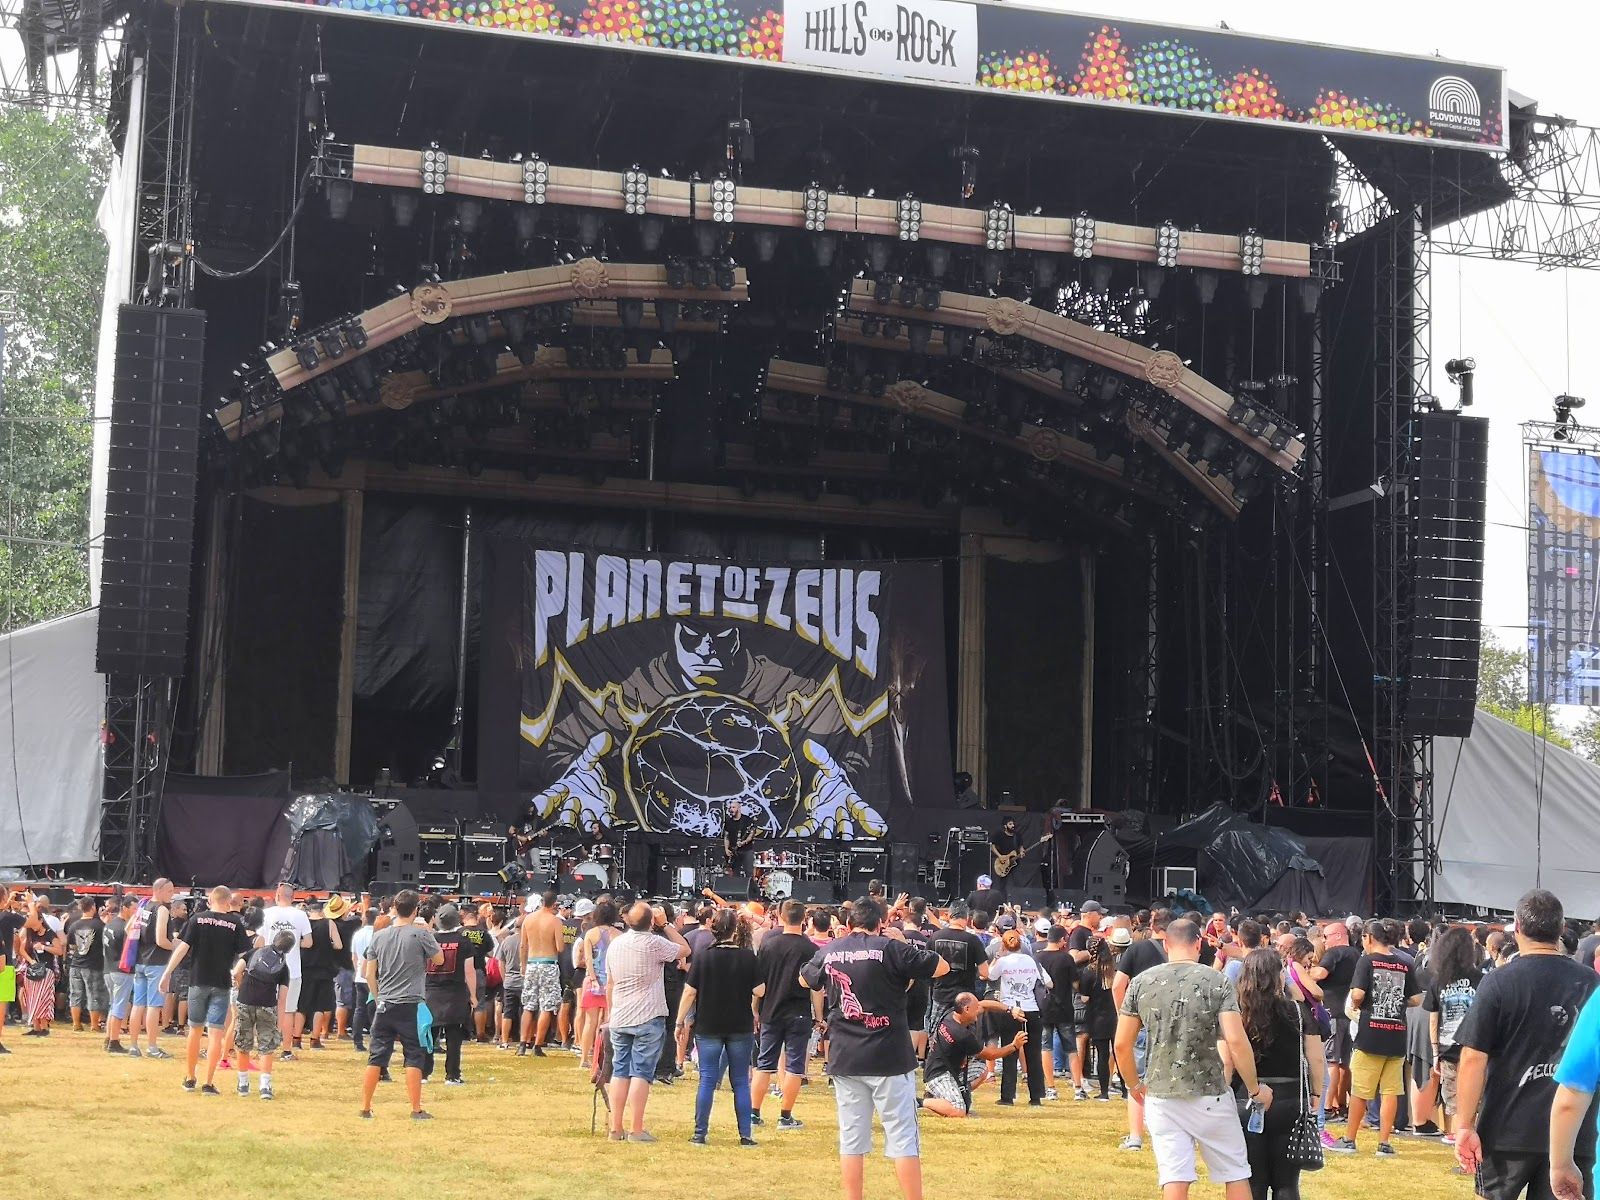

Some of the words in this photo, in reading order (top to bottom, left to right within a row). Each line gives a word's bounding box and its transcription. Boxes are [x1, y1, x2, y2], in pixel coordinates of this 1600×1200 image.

[805, 0, 868, 56] HILLS
[870, 28, 893, 42] OF
[896, 4, 957, 67] ROCK
[1429, 111, 1463, 123] PLOVDIV
[1463, 116, 1481, 127] 2019
[534, 549, 721, 670] PLANET
[723, 565, 761, 606] OF
[764, 567, 881, 681] ZEUS
